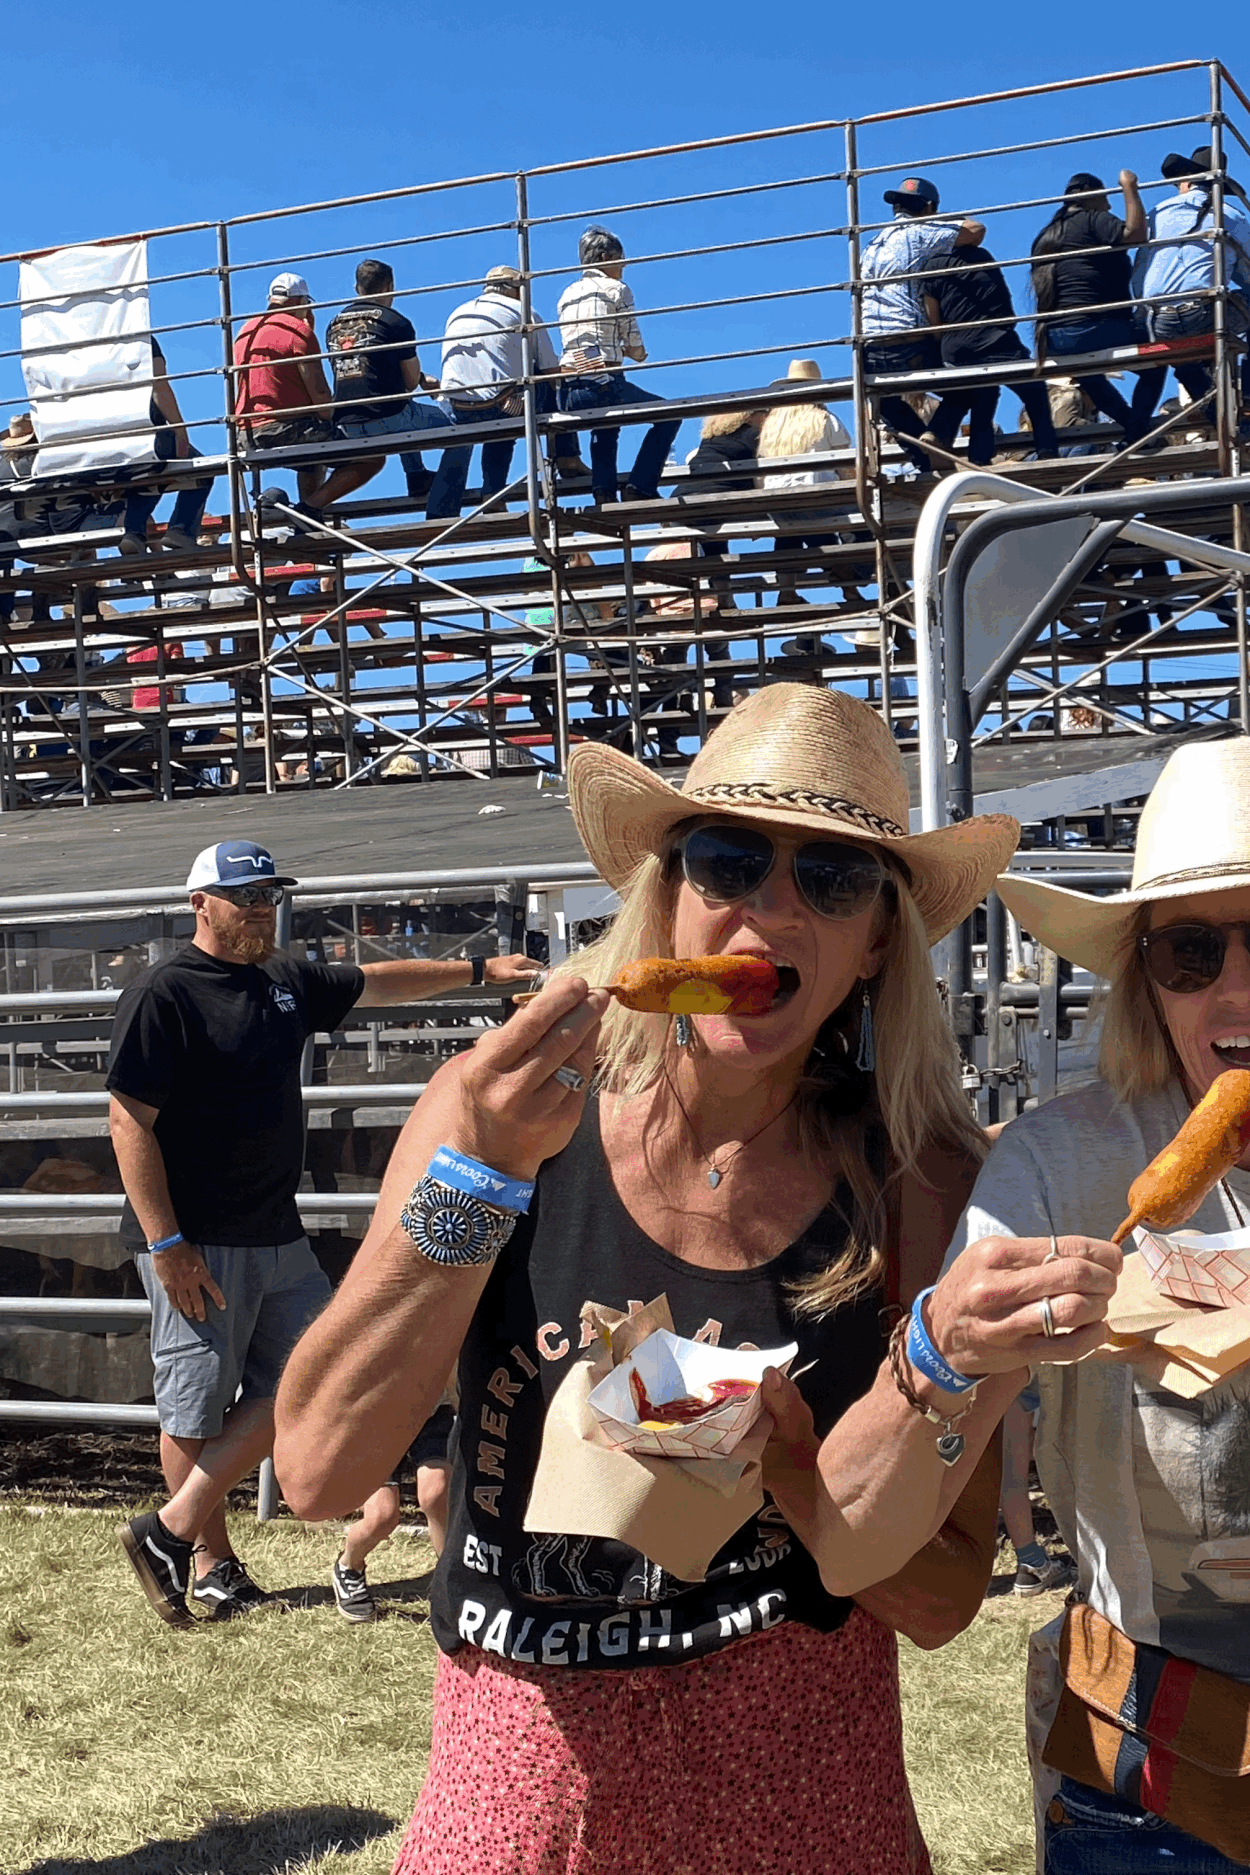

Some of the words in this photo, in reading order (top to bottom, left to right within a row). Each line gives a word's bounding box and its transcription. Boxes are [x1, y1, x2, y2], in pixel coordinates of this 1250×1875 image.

[455, 1162, 490, 1190] Coors
[515, 1188, 534, 1199] GHT
[473, 1299, 646, 1518] AMERIC
[462, 1533, 502, 1576] EST
[457, 1599, 694, 1665] RALEIGH,
[716, 1588, 788, 1638] NC
